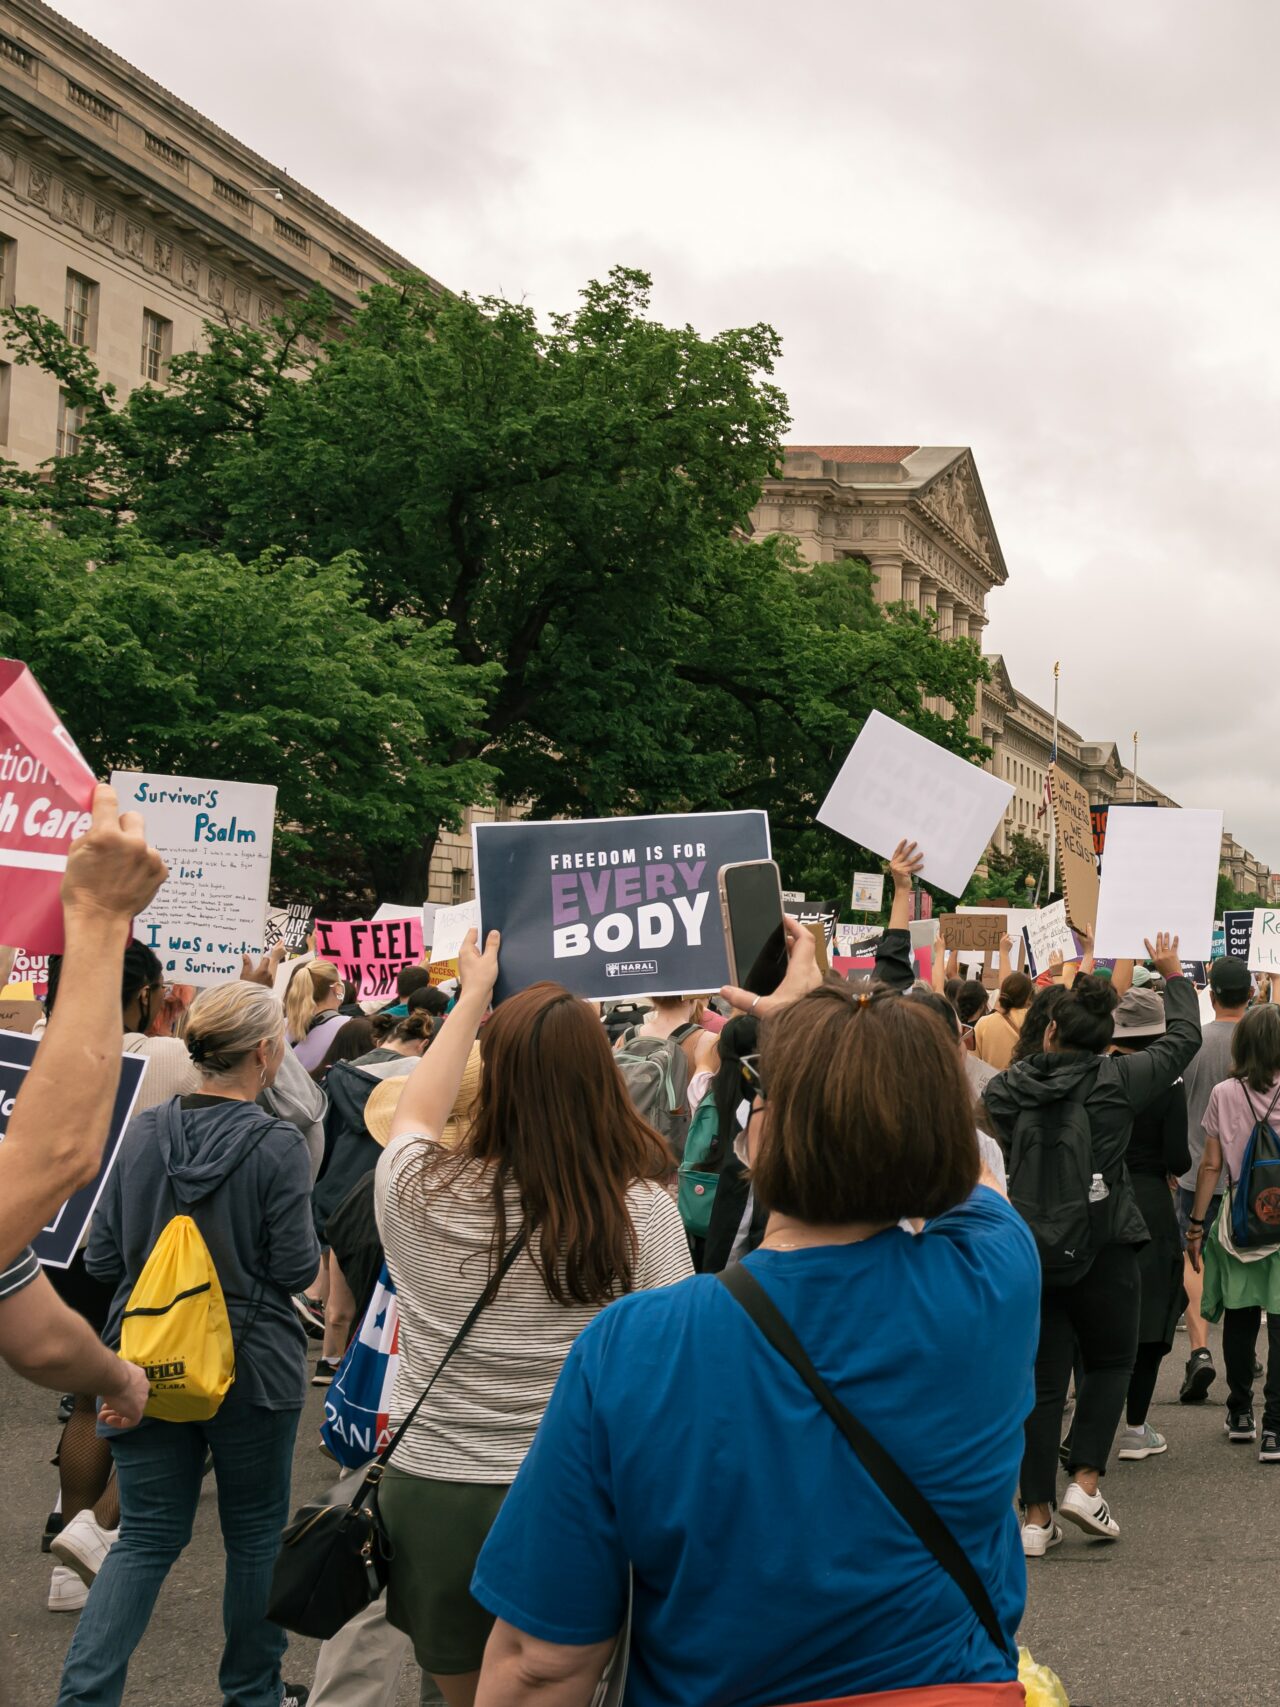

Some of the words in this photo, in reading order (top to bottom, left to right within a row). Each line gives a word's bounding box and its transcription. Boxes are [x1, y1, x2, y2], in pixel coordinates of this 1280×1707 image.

[0, 744, 49, 785] tion
[1058, 777, 1071, 796] WE
[1074, 790, 1087, 807] ARE
[23, 797, 93, 841] Care
[1058, 795, 1090, 826] RUTHLESS
[194, 812, 256, 843] Psalm
[1071, 821, 1082, 839] WE
[551, 849, 636, 870] FREEDOM
[646, 846, 663, 860] IS
[673, 843, 706, 859] FOR
[1063, 830, 1095, 865] RESIST
[179, 867, 204, 879] lost
[551, 861, 707, 926] EVERY
[287, 904, 313, 918] HOW
[553, 891, 710, 959] BODY
[944, 917, 972, 928] THIS
[978, 917, 1000, 928] IS
[147, 924, 162, 948] I
[206, 942, 214, 954] a
[217, 941, 262, 955] victim
[283, 933, 303, 947] HEY.
[287, 918, 310, 935] ARE
[317, 923, 341, 956] I
[350, 922, 419, 959] FEEL
[166, 959, 176, 972] a
[184, 957, 236, 975] Survivor
[1231, 947, 1247, 955] Our
[428, 967, 456, 977] ACCESS
[325, 1401, 396, 1453] PANA
